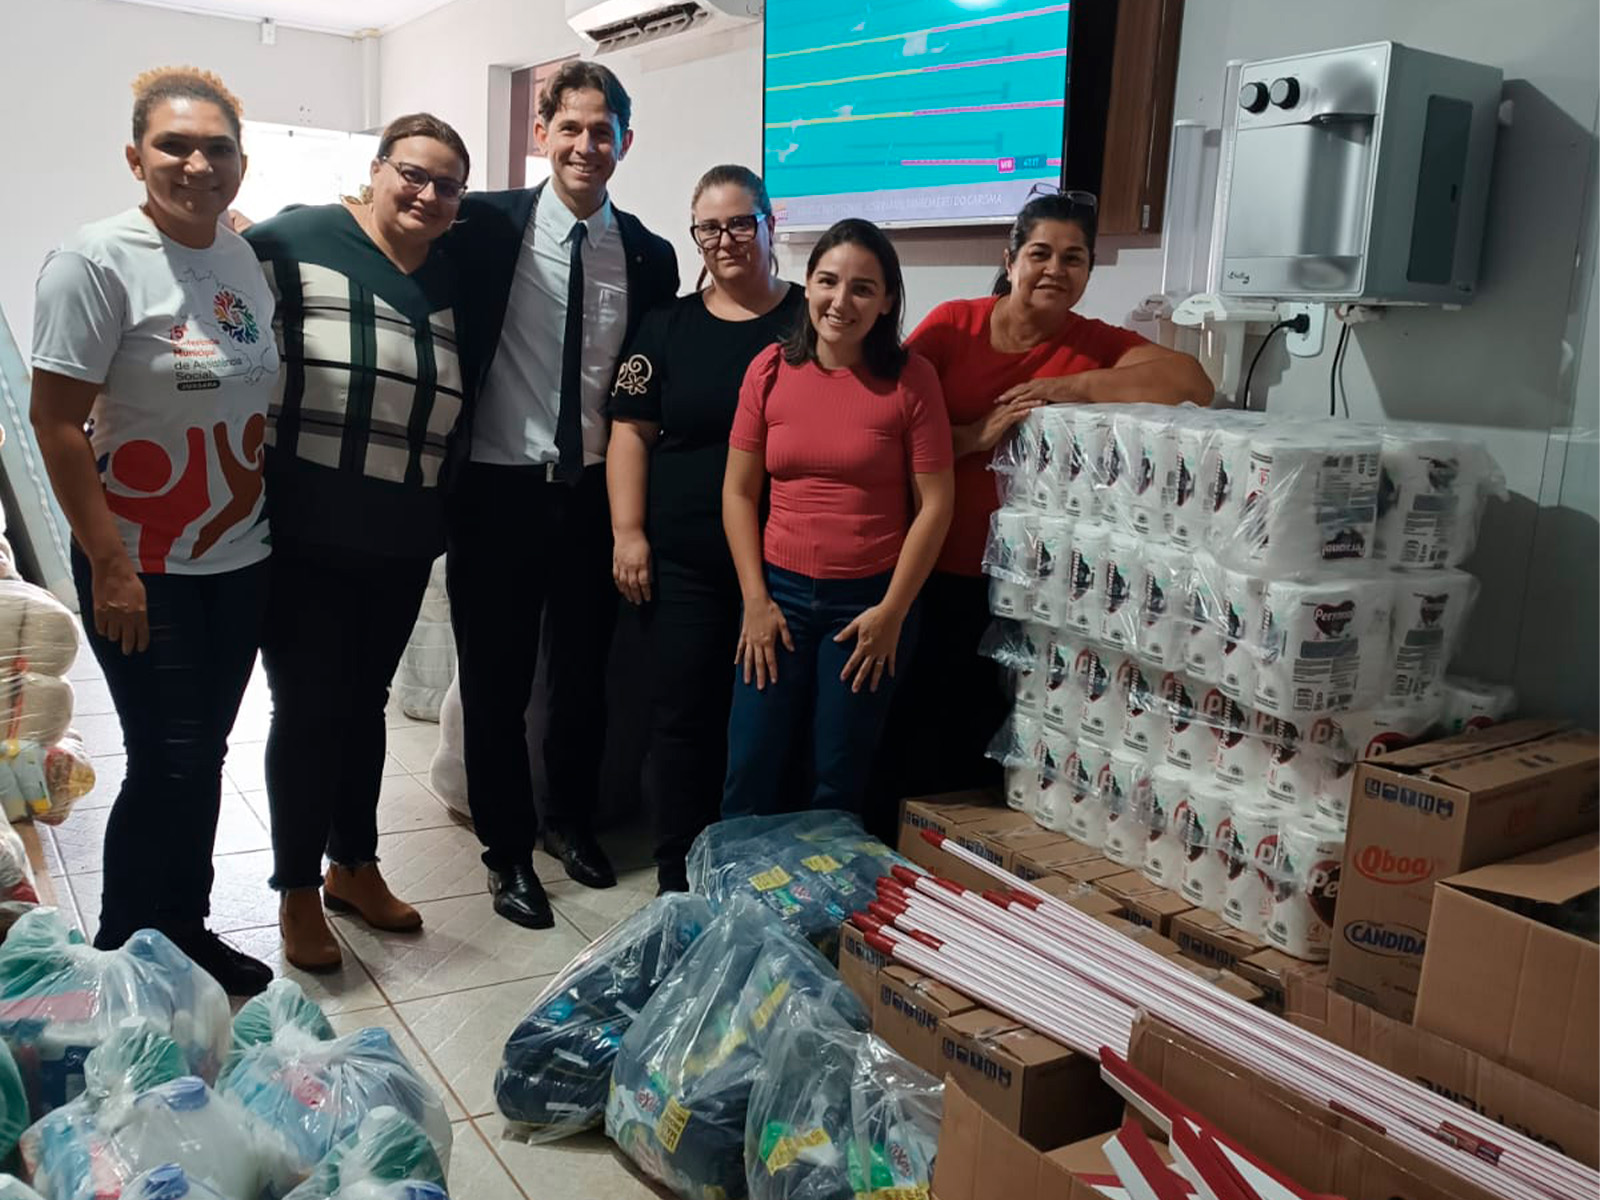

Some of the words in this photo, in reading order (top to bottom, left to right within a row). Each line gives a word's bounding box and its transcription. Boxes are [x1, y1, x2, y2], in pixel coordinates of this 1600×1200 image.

[174, 361, 190, 370] de
[175, 370, 214, 381] Social
[1361, 845, 1427, 876] Qboa
[1306, 867, 1340, 898] Pe
